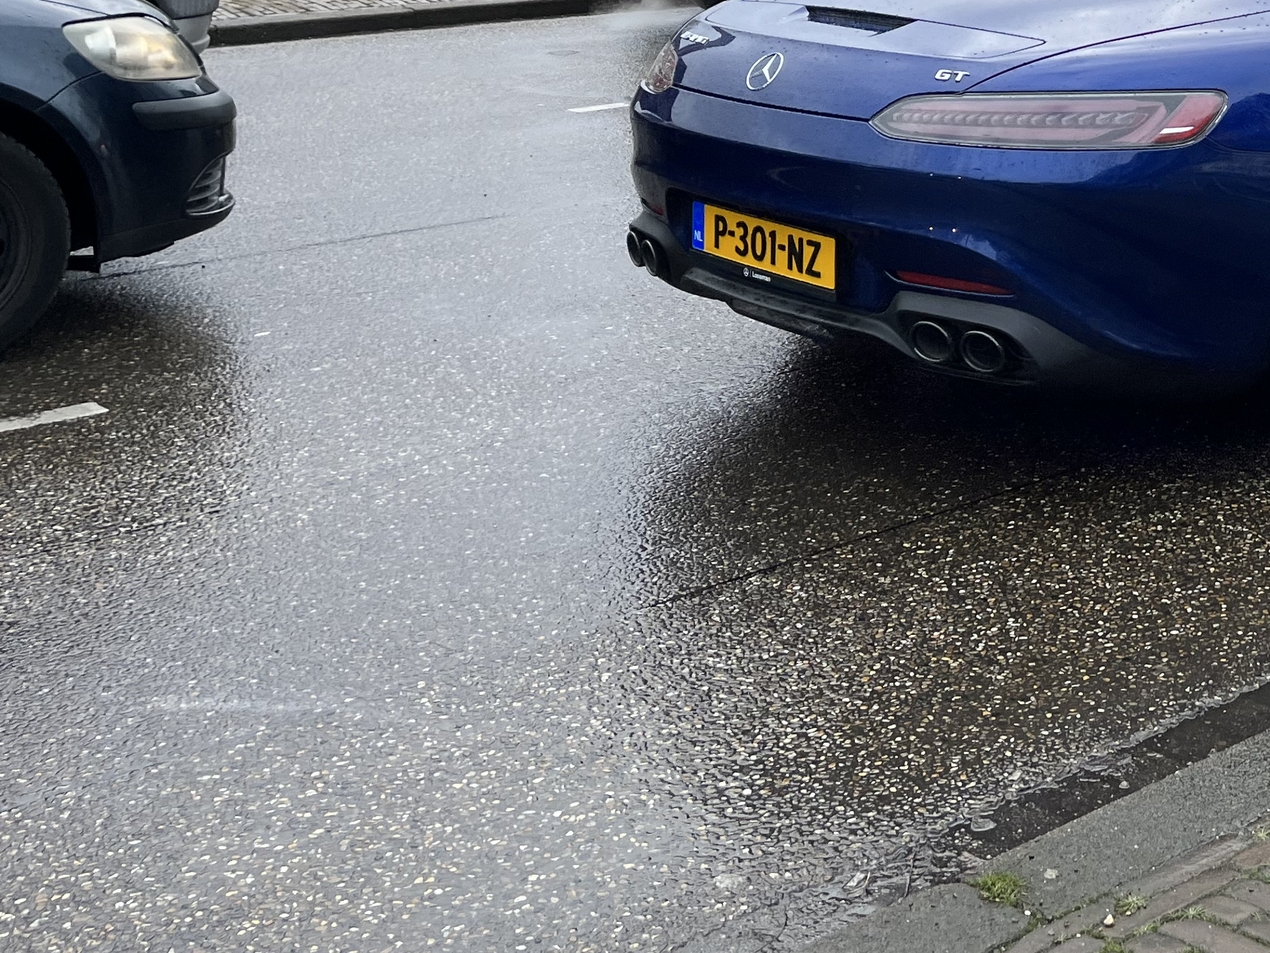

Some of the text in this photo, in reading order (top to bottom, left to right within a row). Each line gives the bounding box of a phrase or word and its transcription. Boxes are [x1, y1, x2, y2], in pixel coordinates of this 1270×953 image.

[934, 68, 970, 83] GT
[693, 230, 703, 242] NL
[713, 213, 822, 279] P-301-NZ
